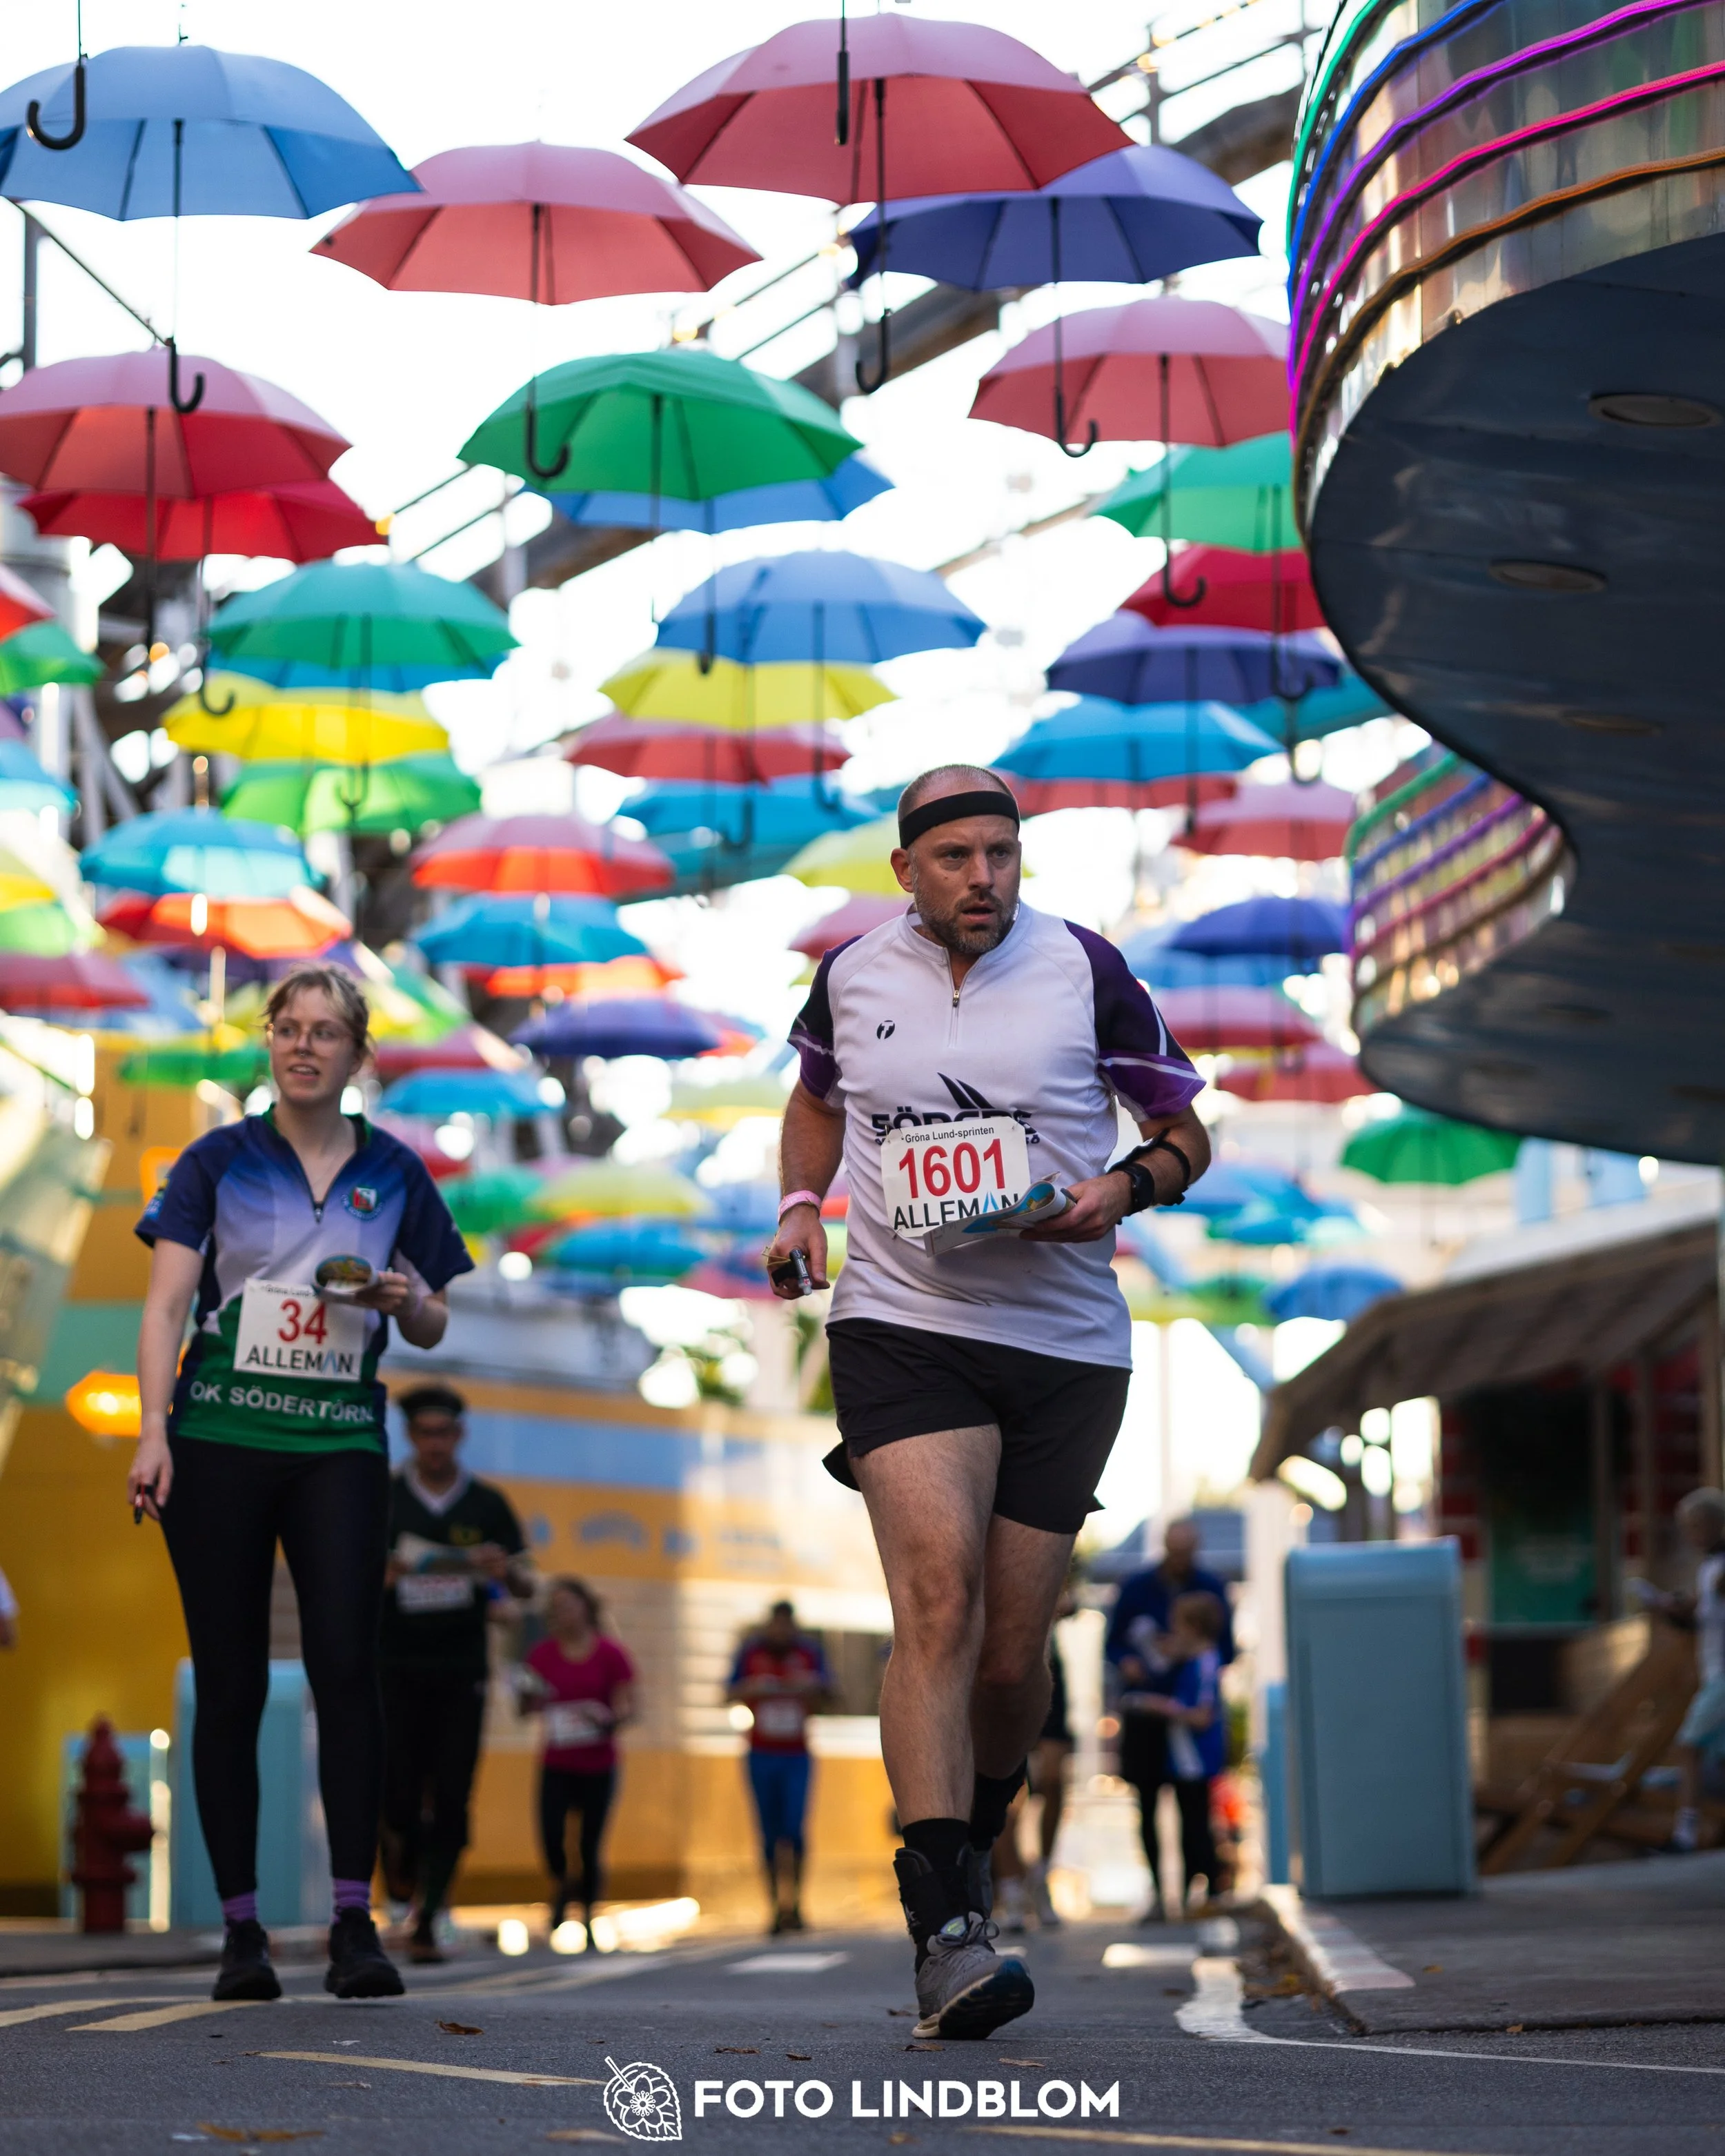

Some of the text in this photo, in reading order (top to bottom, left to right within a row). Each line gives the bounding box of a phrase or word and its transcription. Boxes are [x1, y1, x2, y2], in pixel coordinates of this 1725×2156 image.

[905, 1126, 994, 1143] Gröna Lund-sprinten
[899, 1138, 1005, 1198] 1601
[277, 1298, 328, 1345] 34
[246, 1344, 354, 1375] ALLEMAN
[190, 1381, 374, 1423] OK SÖDERTÖRN
